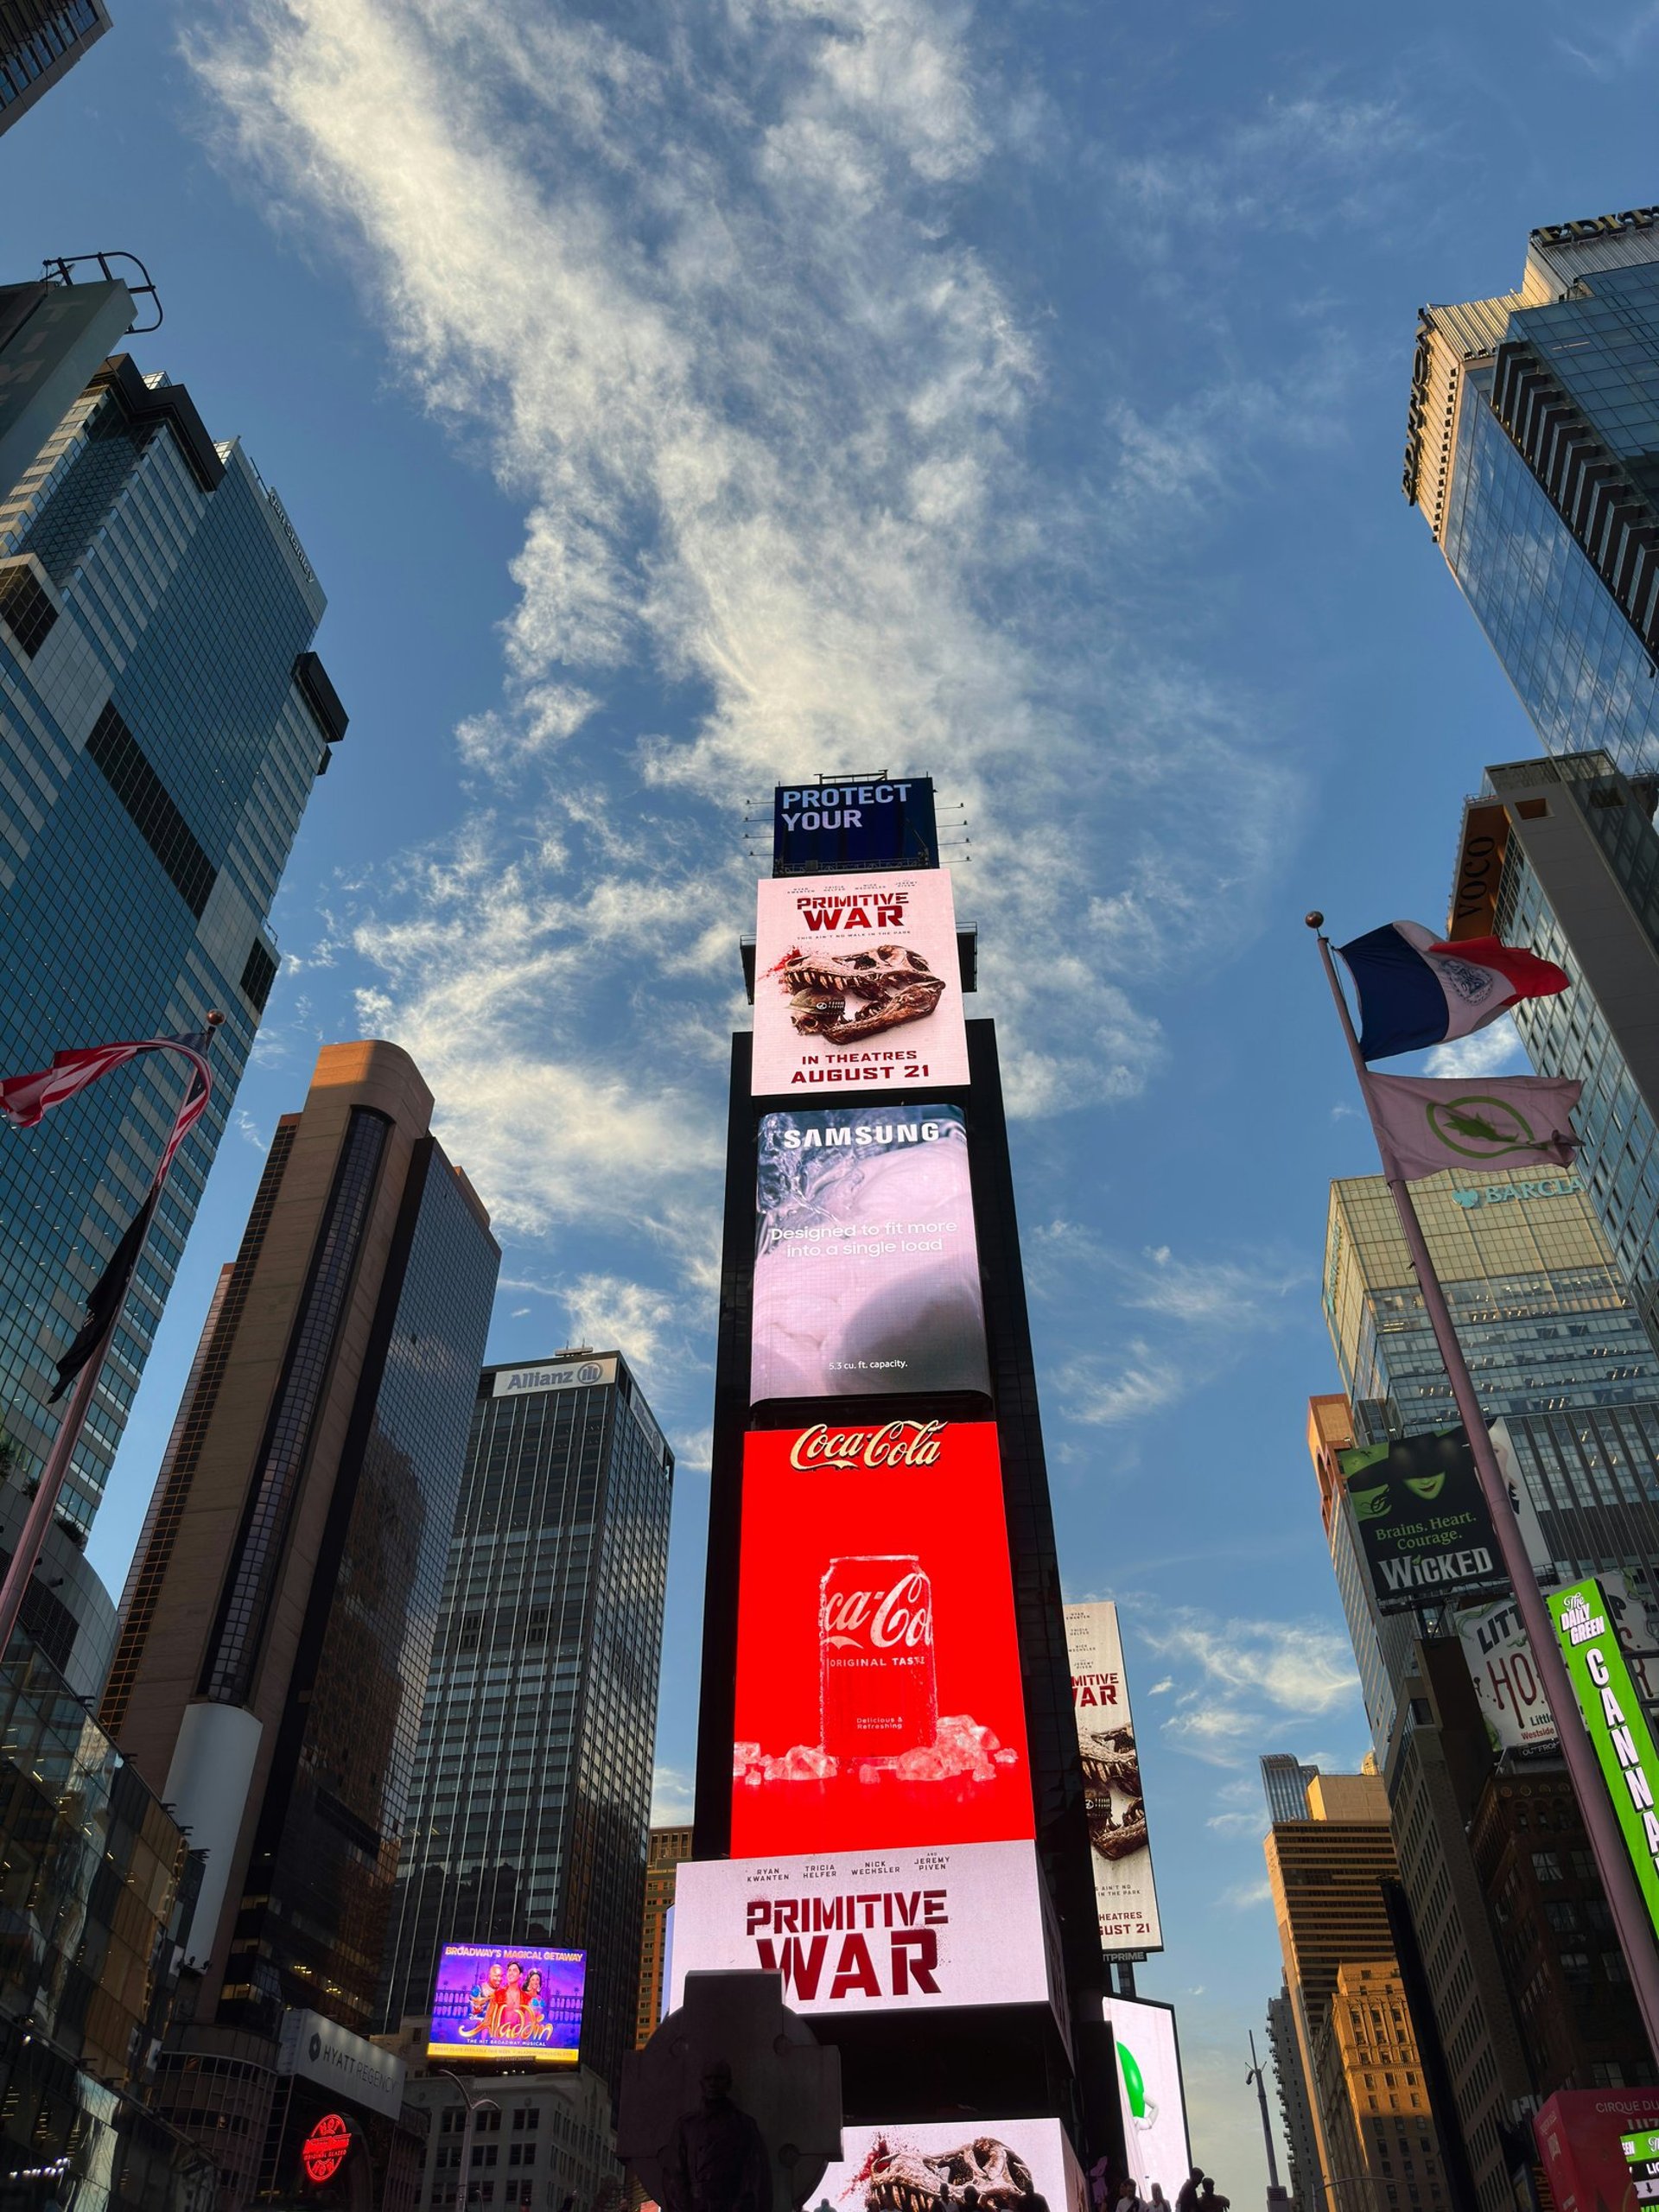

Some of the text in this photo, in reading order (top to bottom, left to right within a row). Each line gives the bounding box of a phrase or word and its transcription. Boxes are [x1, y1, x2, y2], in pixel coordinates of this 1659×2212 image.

[1530, 205, 1659, 247] EDIT
[1402, 308, 1437, 506] EDITION
[285, 522, 315, 584] Stanley
[783, 784, 912, 810] PROTECT
[781, 809, 862, 832] YOUR
[797, 892, 910, 910] PRIMITIVE
[803, 905, 905, 931] WAR
[802, 1051, 918, 1065] IN THEATRES
[791, 1065, 930, 1084] AUGUST 21
[784, 1122, 940, 1149] SAMSUNG
[1485, 1176, 1586, 1204] BARCLA
[771, 1221, 957, 1241] Designed to fit more
[786, 1239, 943, 1258] into a single load
[829, 1361, 842, 1370] 5.3
[858, 1361, 868, 1370] ft.
[870, 1359, 908, 1370] capacity.
[507, 1370, 574, 1390] Allianz
[790, 1420, 948, 1470] Coca-Cola
[1375, 1511, 1477, 1541] Brains. Heart.
[1396, 1531, 1463, 1552] Courage.
[1563, 1592, 1585, 1612] The
[1560, 1602, 1591, 1633] DAILY
[1477, 1604, 1525, 1656] LITT
[1569, 1615, 1605, 1647] GREEN
[830, 1657, 887, 1667] ORIGINAL
[1071, 1673, 1119, 1687] MITIVE
[1072, 1685, 1118, 1707] AR
[1521, 1727, 1554, 1740] Westside
[1586, 1647, 1659, 1879] CANNA
[851, 1866, 900, 1875] WECHSLER
[747, 1889, 949, 1936] PRIMITIVE
[1099, 1911, 1142, 1921] HEATRES
[1099, 1923, 1150, 1936] GUST 21
[445, 1946, 583, 1961] BROADWAY'S MAGICAL GETAWAY
[756, 1928, 942, 2002] WAR
[458, 2002, 554, 2041] Aladdin
[323, 2045, 397, 2094] HYATT REGENCY
[1595, 2101, 1641, 2115] CIRQUE
[319, 2119, 341, 2134] HOT
